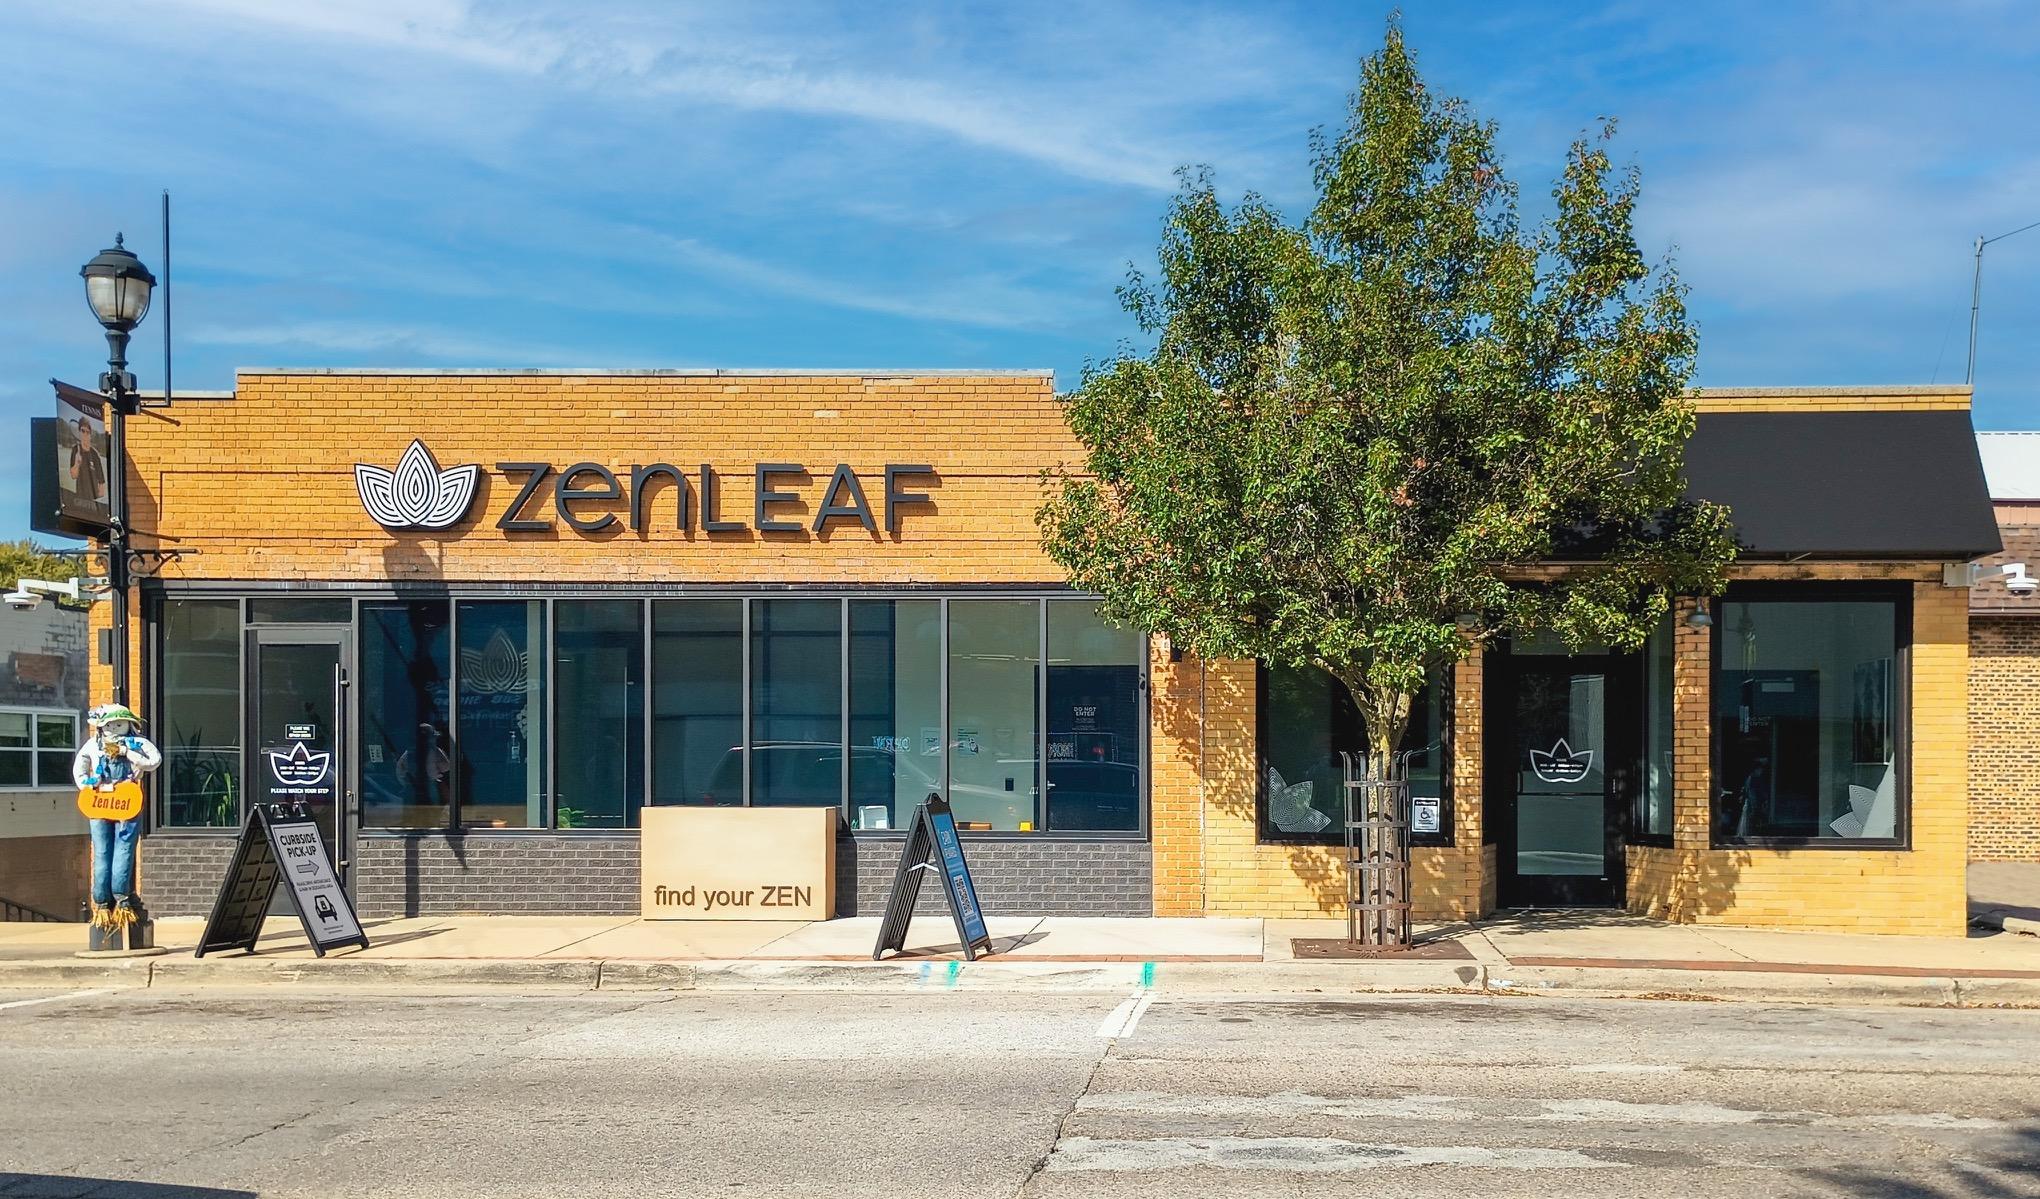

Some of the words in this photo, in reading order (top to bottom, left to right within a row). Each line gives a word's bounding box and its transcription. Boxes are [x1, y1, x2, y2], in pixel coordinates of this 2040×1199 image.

[92, 795, 109, 809] Zen
[110, 796, 131, 811] Leaf
[280, 833, 317, 846] CURBSIDE
[287, 845, 317, 858] PICK-UP
[654, 885, 695, 906] find
[703, 890, 754, 911] your
[760, 885, 812, 907] ZEN
